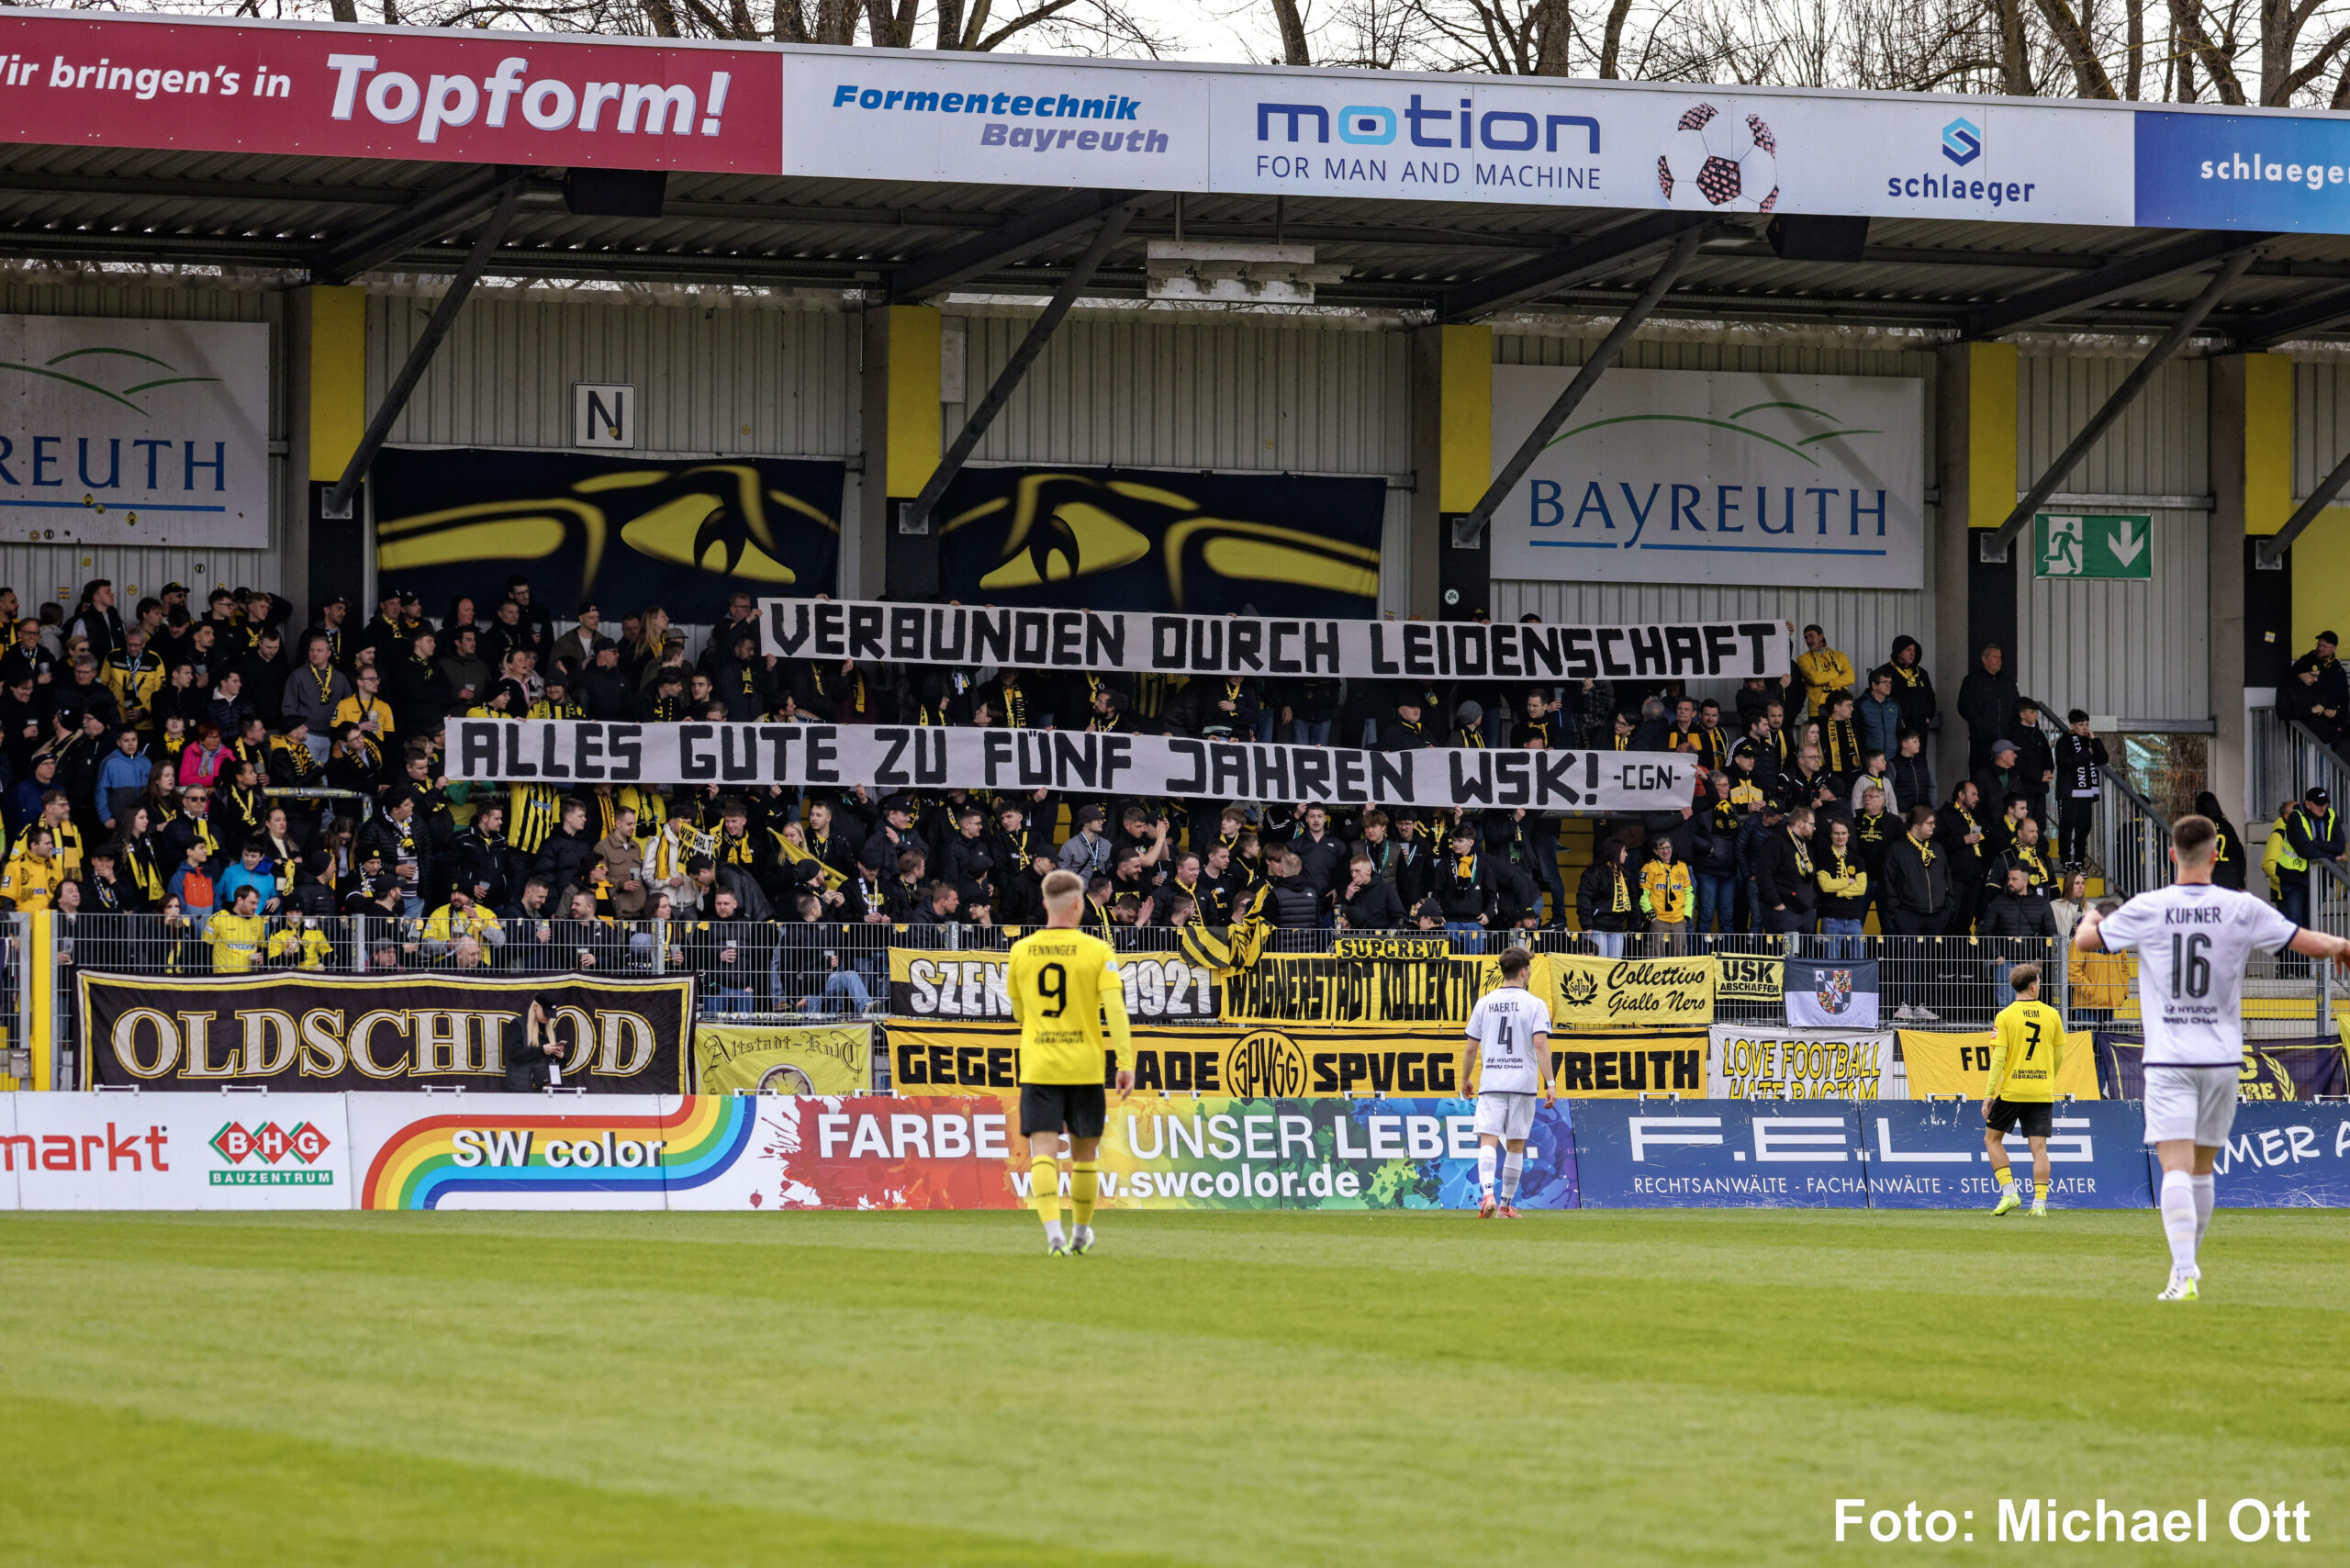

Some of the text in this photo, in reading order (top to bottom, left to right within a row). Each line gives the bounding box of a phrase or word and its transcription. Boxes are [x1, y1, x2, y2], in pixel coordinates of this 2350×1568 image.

[0, 54, 39, 86] ir
[253, 66, 291, 97] in
[327, 53, 732, 143] Topform!
[833, 84, 1142, 122] Formentechnik
[980, 123, 1169, 154] Bayreuth
[1257, 94, 1600, 153] motion
[1257, 154, 1601, 190] FOR MAN AND MACHINE
[1888, 173, 2035, 207] schlaeger
[2200, 152, 2350, 190] schlaege
[588, 391, 623, 441] N
[771, 602, 1777, 679] VERBUNDEN DURCH LEIDENSCHAFT
[462, 722, 642, 780] ALLES
[679, 725, 839, 783] GUTE
[875, 728, 947, 785] ZU
[985, 729, 1133, 790] FÜNF
[1166, 740, 1416, 802] JAHREN
[1449, 751, 1599, 806] WSK!
[2165, 907, 2221, 924] KUFNER
[1027, 944, 1077, 957] FENNINGER
[1341, 938, 1445, 959] SUPCREW
[2172, 933, 2211, 999] 16
[909, 958, 1212, 1017] SZEN 1921
[1038, 962, 1067, 1018] 9
[1227, 958, 1483, 1022] WAGNERSTADT KOLLEKTIV
[1607, 961, 1705, 991] Collettivo
[1719, 982, 1780, 994] ABSCHAFFEN
[1723, 960, 1774, 985] USK
[1488, 1002, 1520, 1013] HAERTL
[1608, 990, 1706, 1019] Giallo Nero
[2022, 1010, 2040, 1018] HEIM
[1497, 1016, 1513, 1055] 4
[2024, 1021, 2041, 1060] 7
[1314, 1052, 1456, 1092] SPVGG
[1722, 1038, 1881, 1081] LOVE FOOTBALL
[1960, 1046, 1991, 1071] FO
[229, 1132, 319, 1154] BHG
[452, 1129, 667, 1168] SW color
[818, 1114, 1010, 1159] FARBE
[1127, 1114, 1315, 1159] UNSER
[1334, 1115, 1539, 1159] LEBE.
[213, 1172, 330, 1184] BAUZENTRUM
[1634, 1175, 2097, 1193] RECHTSANWÄLTE FACHANWÄLTE STEURBRATER
